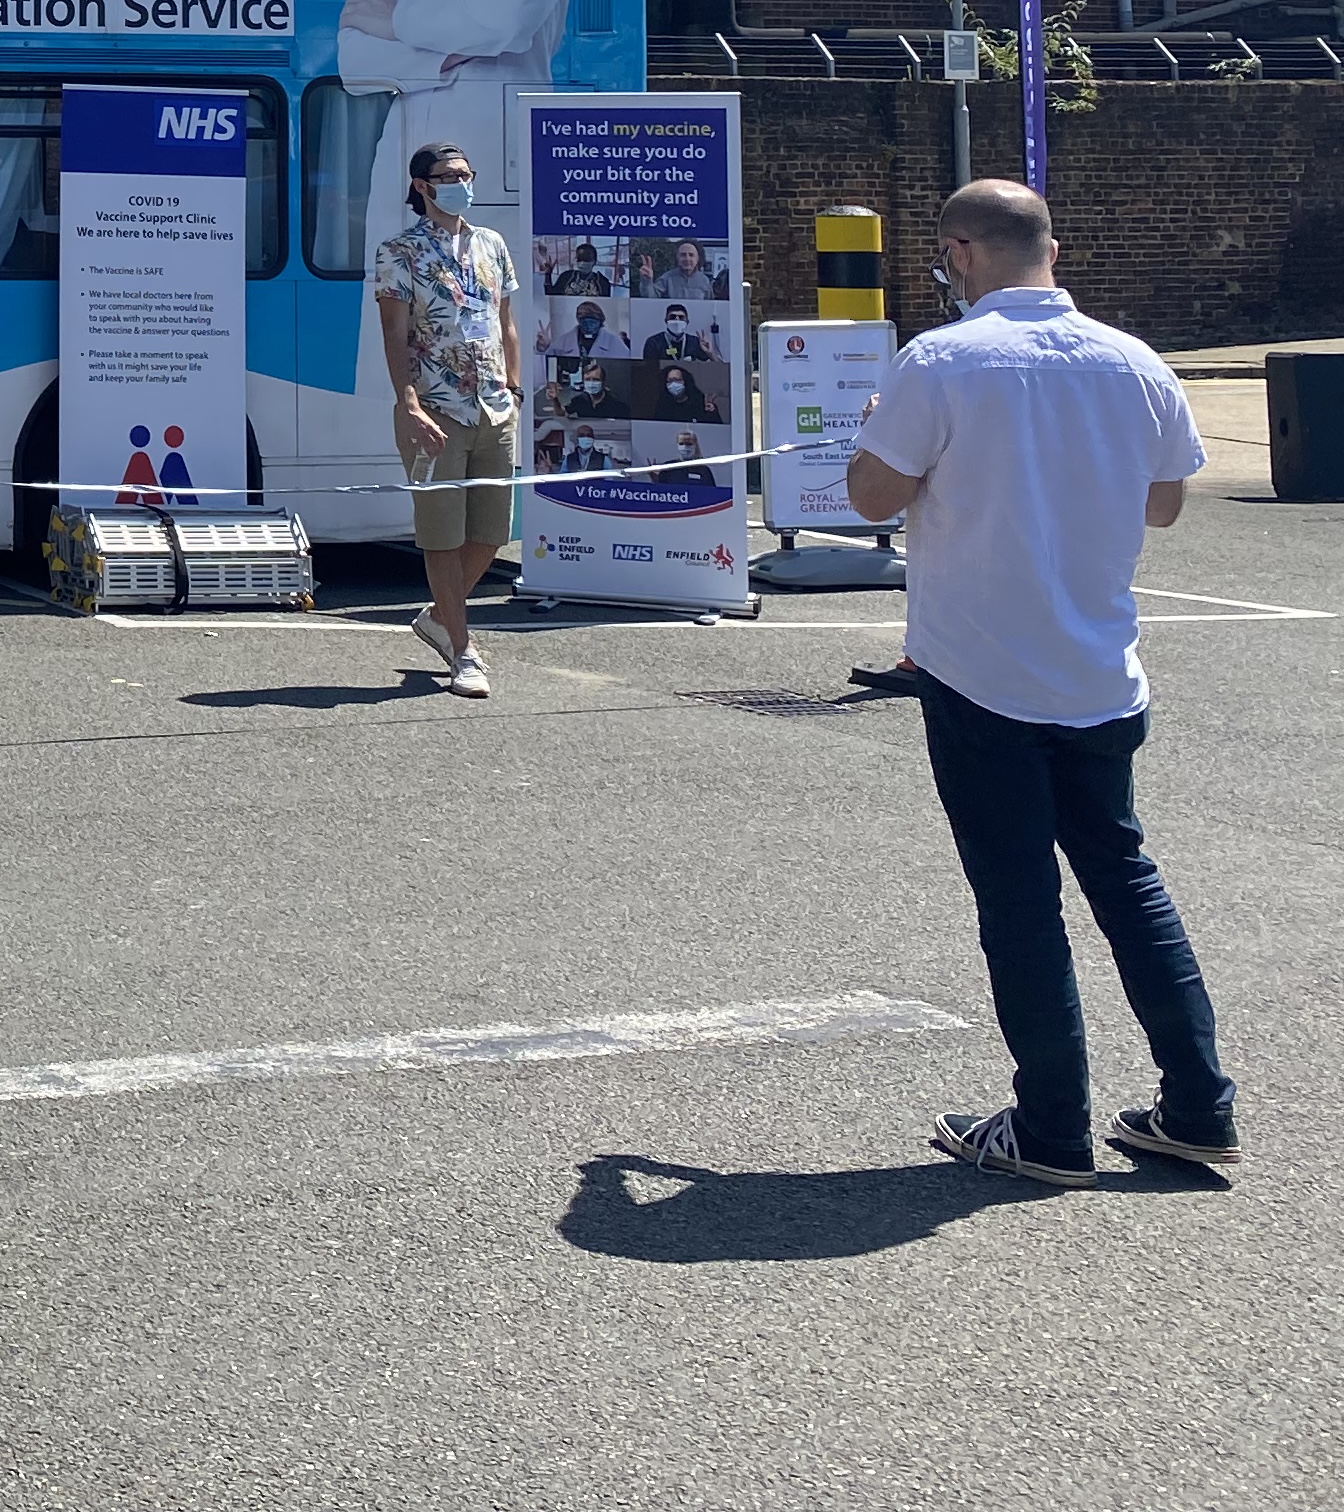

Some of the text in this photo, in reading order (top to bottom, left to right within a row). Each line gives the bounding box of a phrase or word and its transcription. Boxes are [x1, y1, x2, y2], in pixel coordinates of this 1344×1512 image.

[157, 107, 238, 141] NHS
[575, 120, 609, 136] had
[613, 124, 641, 139] my
[644, 121, 716, 138] vaccine,
[552, 143, 707, 162] make sure you do
[563, 165, 695, 184] your bit for the
[128, 196, 180, 207] COVID 19
[559, 189, 698, 208] community and
[95, 211, 217, 225] Vaccine Support Clinic
[562, 210, 697, 230] have yours too.
[76, 226, 234, 241] We are here to help save lives
[88, 265, 164, 276] The Vaccine is SAFE
[88, 290, 214, 301] We have local doctors here from
[88, 303, 215, 313] your community who would like
[98, 314, 122, 324] speak
[122, 315, 141, 323] with
[141, 316, 158, 325] you
[158, 315, 182, 324] about
[183, 315, 212, 326] having
[88, 326, 230, 338] the vaccine & answer your questions
[88, 349, 209, 361] Please take a moment to speak
[88, 361, 106, 370] with
[117, 362, 124, 370] it
[124, 362, 149, 372] might
[150, 363, 169, 371] save
[169, 363, 188, 372] your
[188, 362, 202, 371] life
[88, 374, 187, 385] and keep your family safe
[798, 413, 821, 427] GH
[575, 486, 689, 504] V for #Vaccinated
[799, 493, 836, 503] ROYAL
[799, 503, 854, 513] GREENWI
[558, 535, 582, 544] KEEP
[558, 544, 595, 554] ENFIELD
[614, 544, 653, 561] NHS
[558, 553, 581, 562] SAFE
[665, 550, 711, 561] ENFIELD
